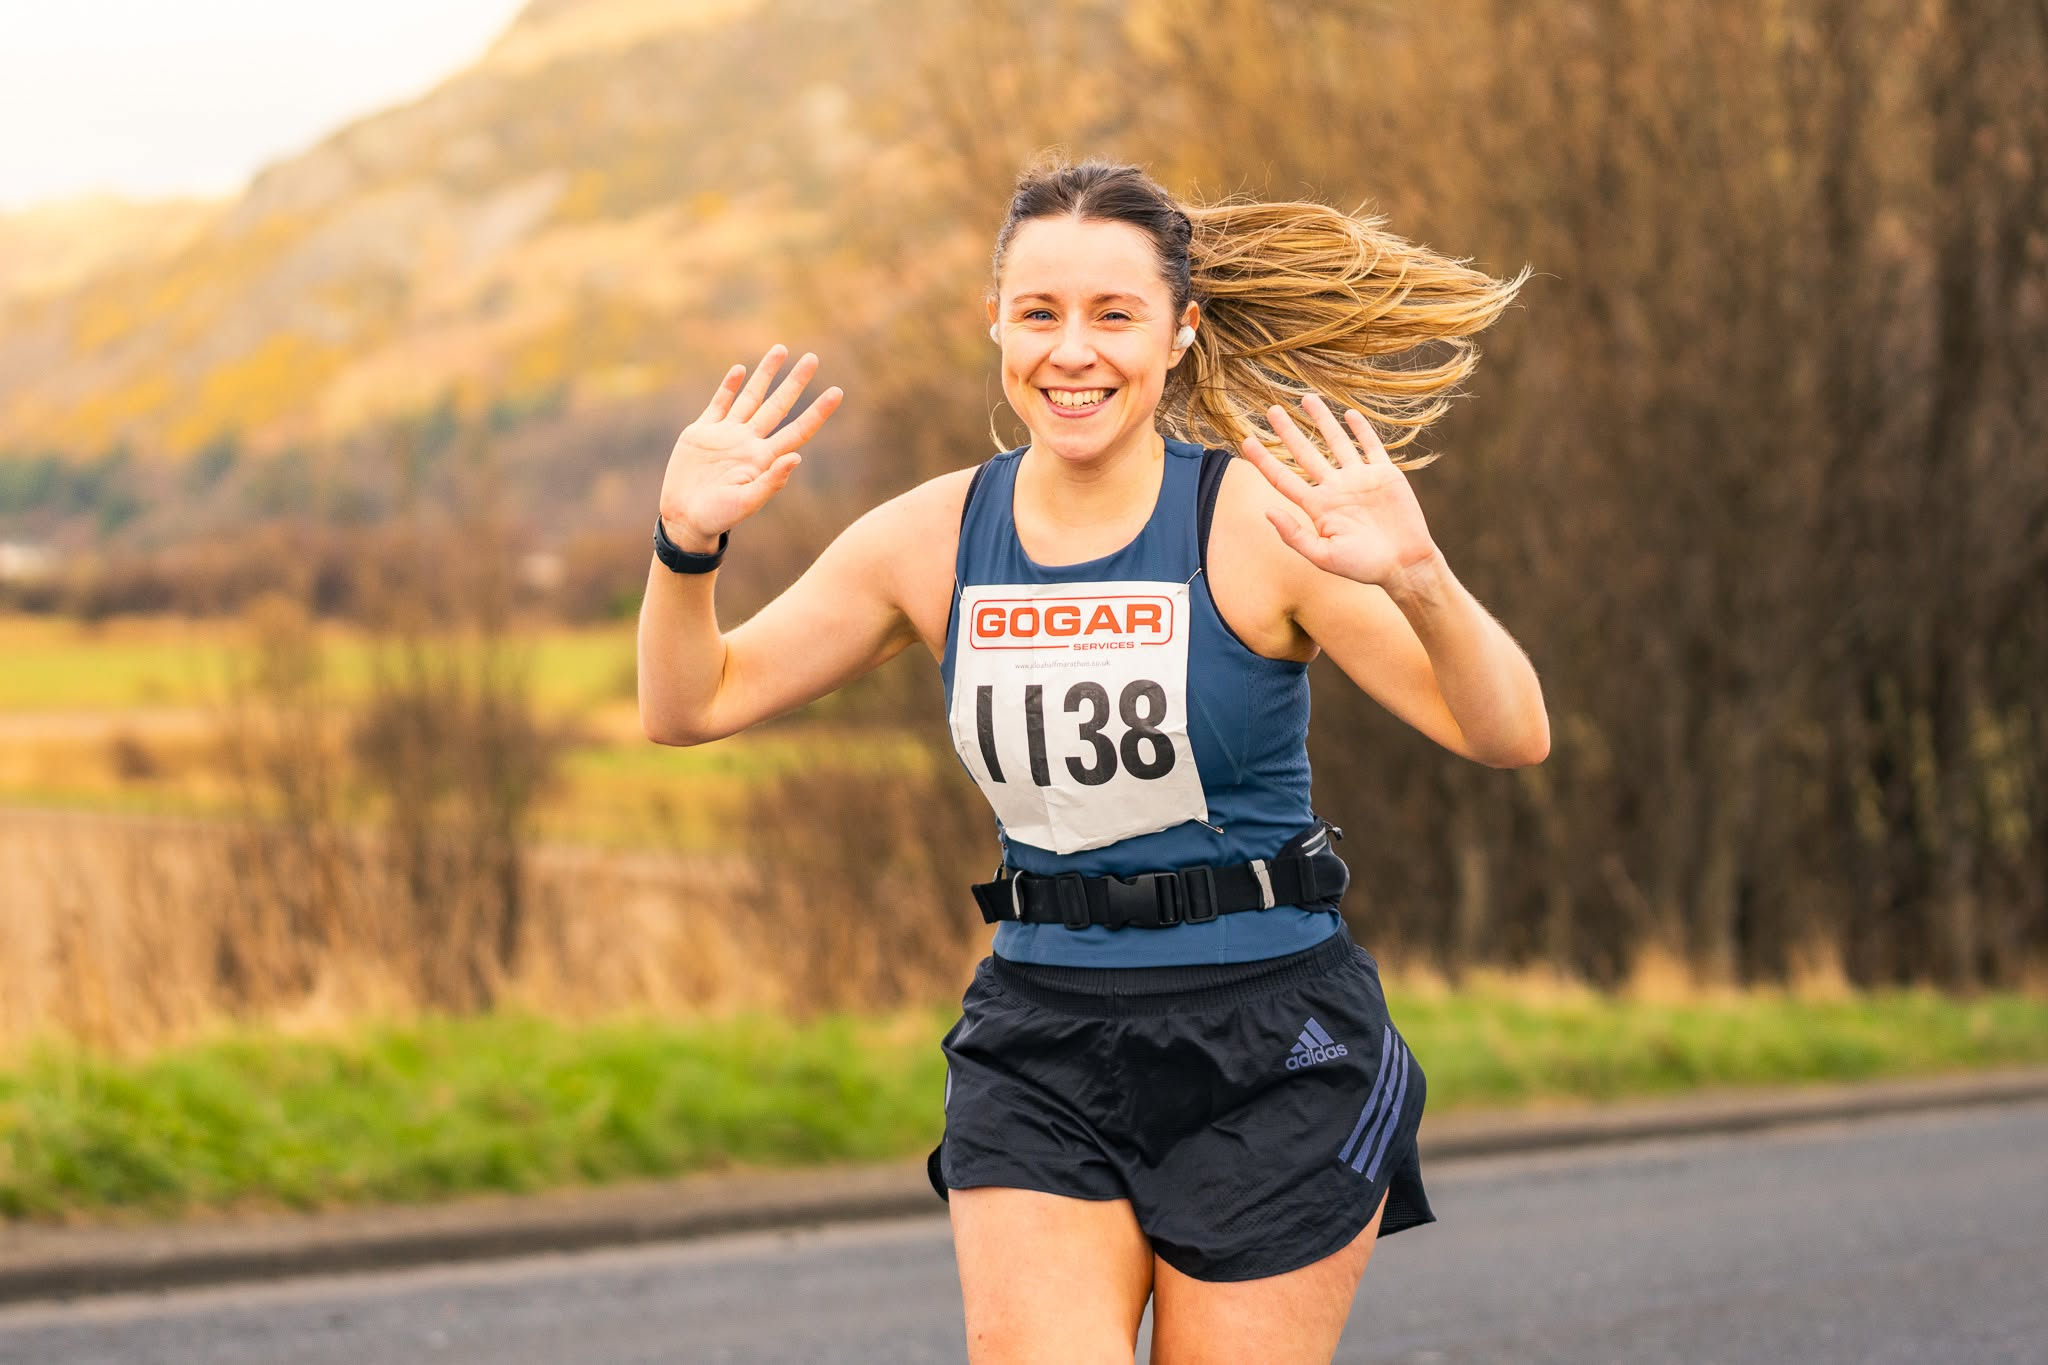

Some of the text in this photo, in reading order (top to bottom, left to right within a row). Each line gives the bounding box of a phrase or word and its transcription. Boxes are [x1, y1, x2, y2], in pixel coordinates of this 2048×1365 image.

[976, 603, 1163, 638] GOGAR
[1072, 640, 1136, 652] SERVICES
[976, 679, 1176, 787] 1138
[1285, 1043, 1349, 1071] adidas
